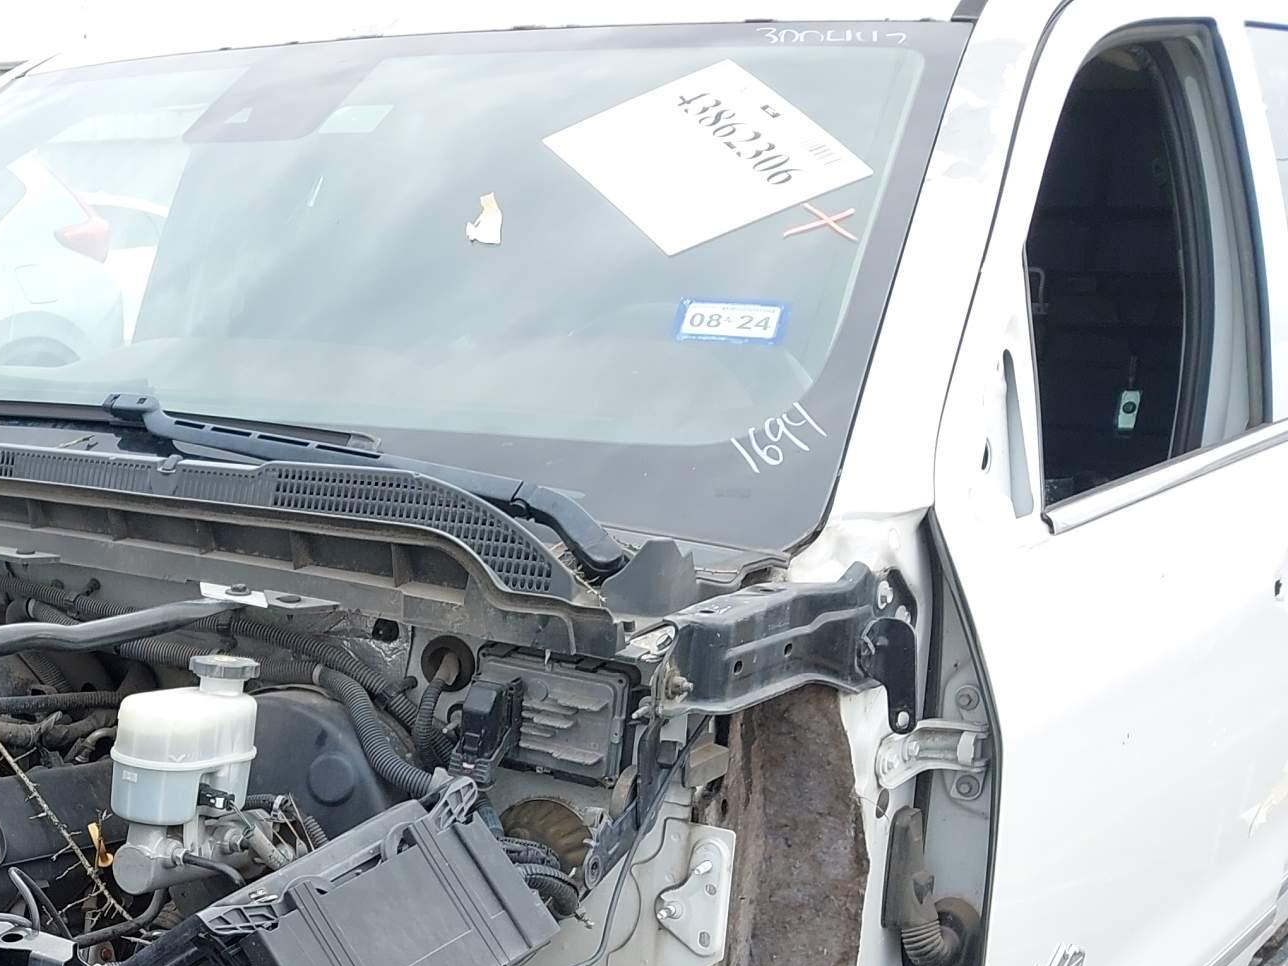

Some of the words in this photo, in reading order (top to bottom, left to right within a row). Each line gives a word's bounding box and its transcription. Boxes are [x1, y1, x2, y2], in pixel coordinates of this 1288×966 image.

[677, 92, 804, 186] 43862306
[689, 312, 722, 328] 08
[736, 314, 771, 331] 24
[730, 401, 828, 474] 1694
